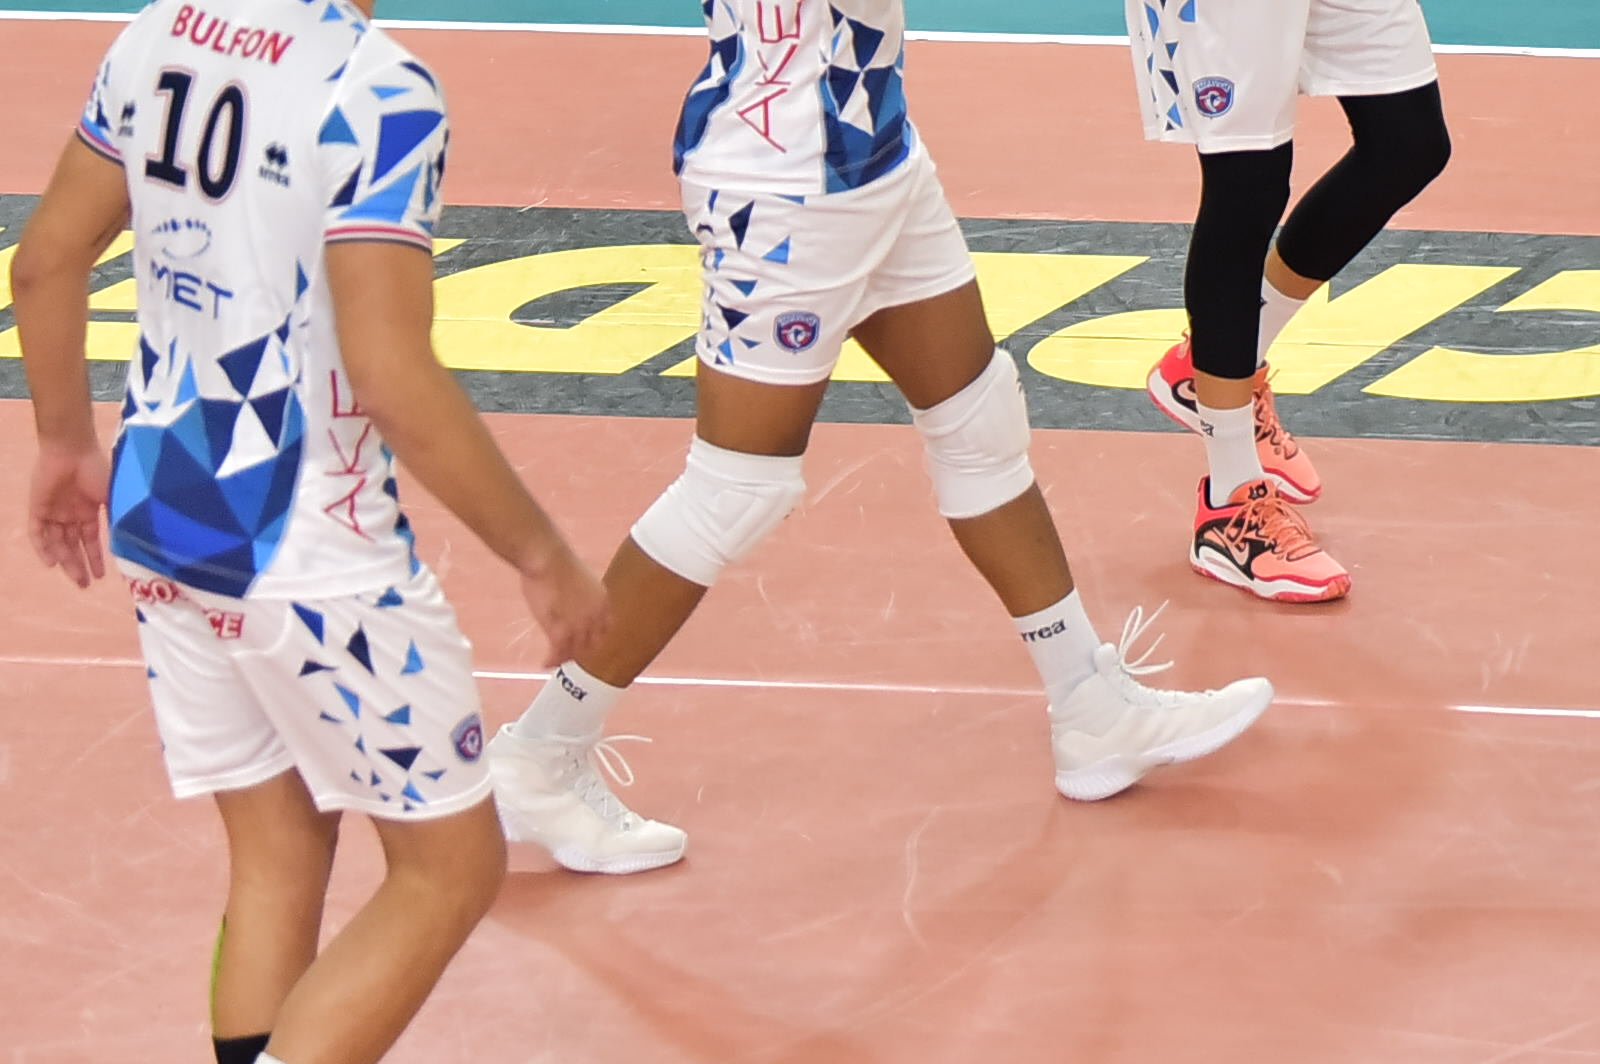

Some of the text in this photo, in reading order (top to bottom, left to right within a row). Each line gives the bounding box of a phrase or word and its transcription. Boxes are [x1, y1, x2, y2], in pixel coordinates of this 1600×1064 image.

[170, 3, 294, 65] BULFON
[143, 67, 246, 203] 10
[149, 259, 233, 320] MET
